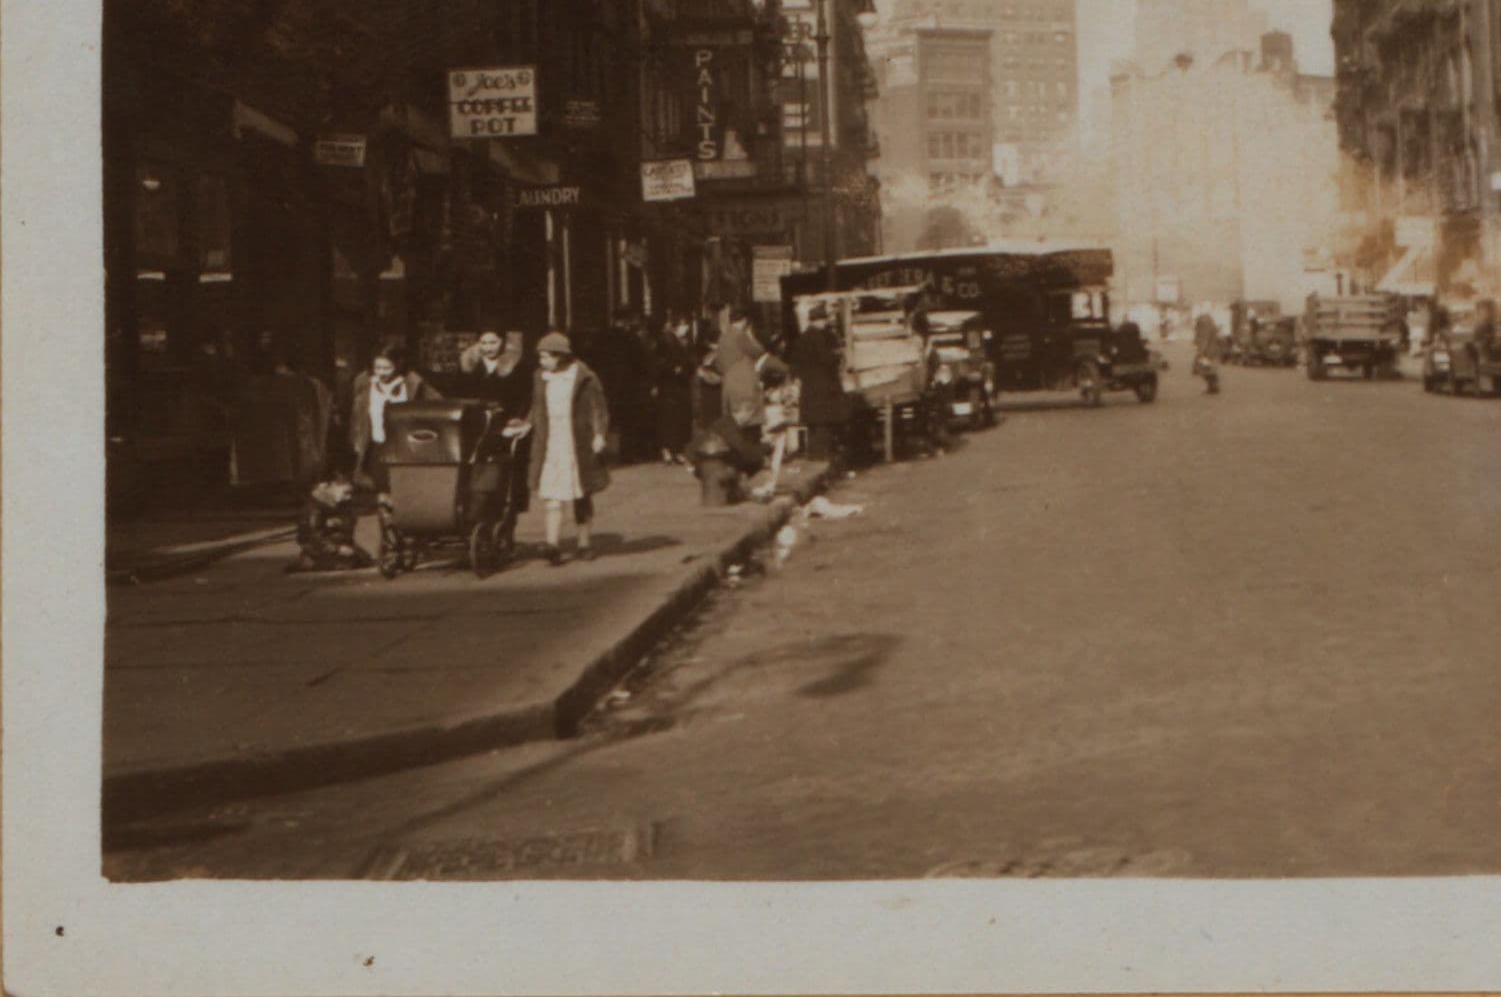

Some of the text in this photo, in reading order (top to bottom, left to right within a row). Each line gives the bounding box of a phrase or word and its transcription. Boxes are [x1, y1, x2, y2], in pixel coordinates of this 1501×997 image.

[467, 73, 516, 96] Joe's
[457, 97, 533, 114] COFFEE
[695, 49, 717, 160] PAINTS
[471, 117, 515, 134] POT
[514, 186, 581, 206] AUNDRY
